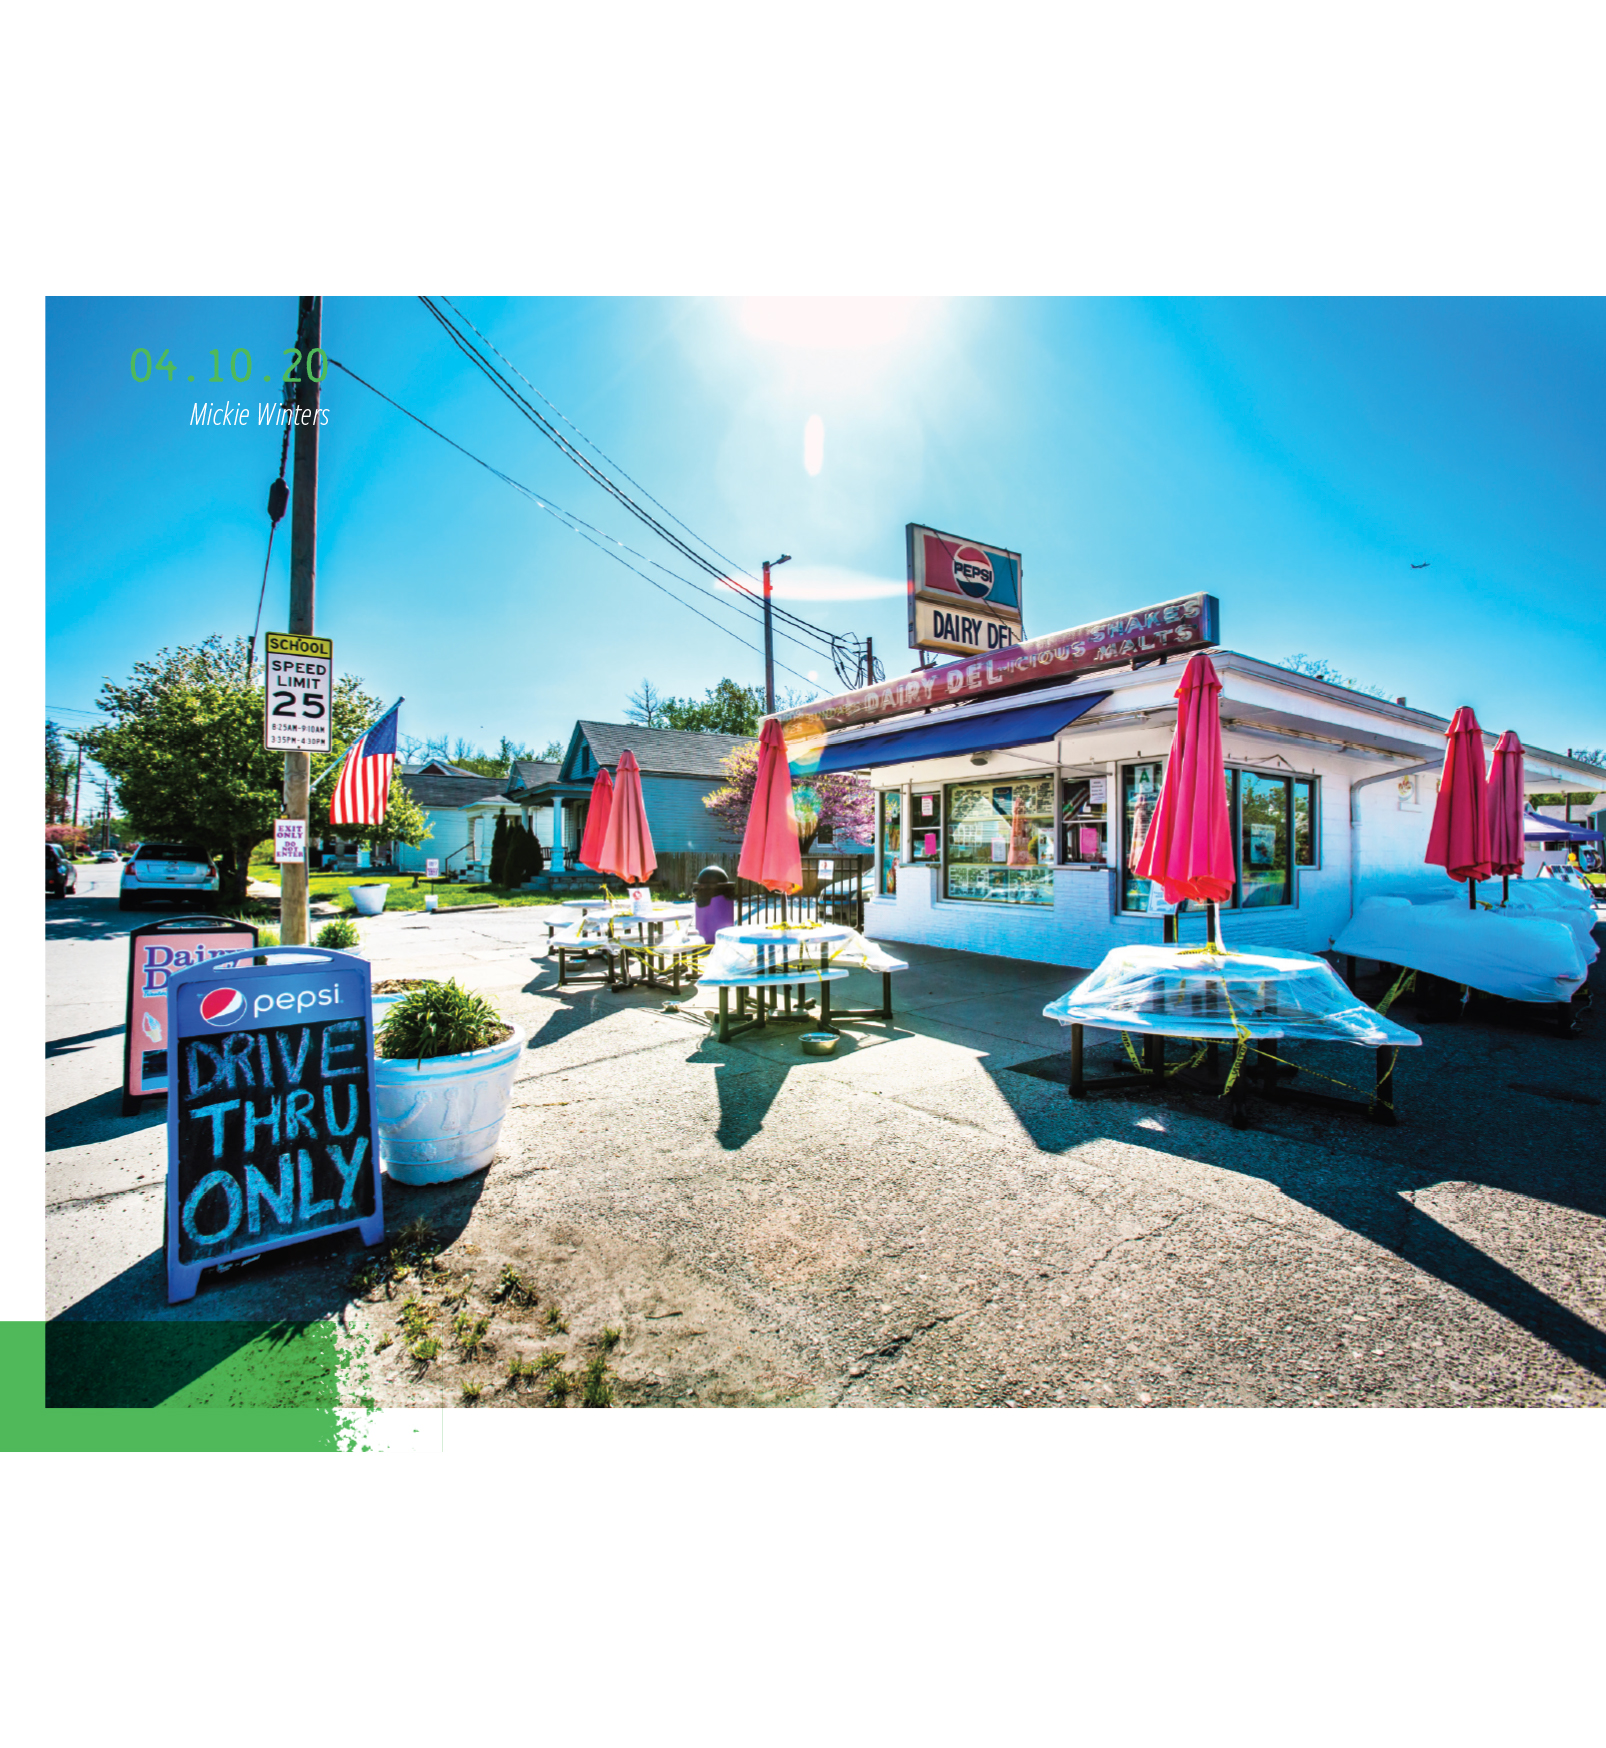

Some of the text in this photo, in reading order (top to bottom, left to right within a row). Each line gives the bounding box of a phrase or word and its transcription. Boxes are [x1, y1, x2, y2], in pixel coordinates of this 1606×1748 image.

[953, 560, 993, 583] PEPSI
[933, 609, 982, 646] DAIRY
[1089, 600, 1200, 643] SHAKES
[270, 638, 328, 655] SCHOOL
[1094, 624, 1193, 661] MALTS
[272, 660, 327, 675] SPEED
[277, 675, 321, 689] LIMIT
[272, 691, 325, 719] 25
[863, 674, 938, 714] DAIRY
[254, 983, 340, 1018] pepsi
[184, 1020, 365, 1101] DRIVE
[189, 1084, 360, 1158] THRU
[182, 1136, 369, 1245] ONLY
